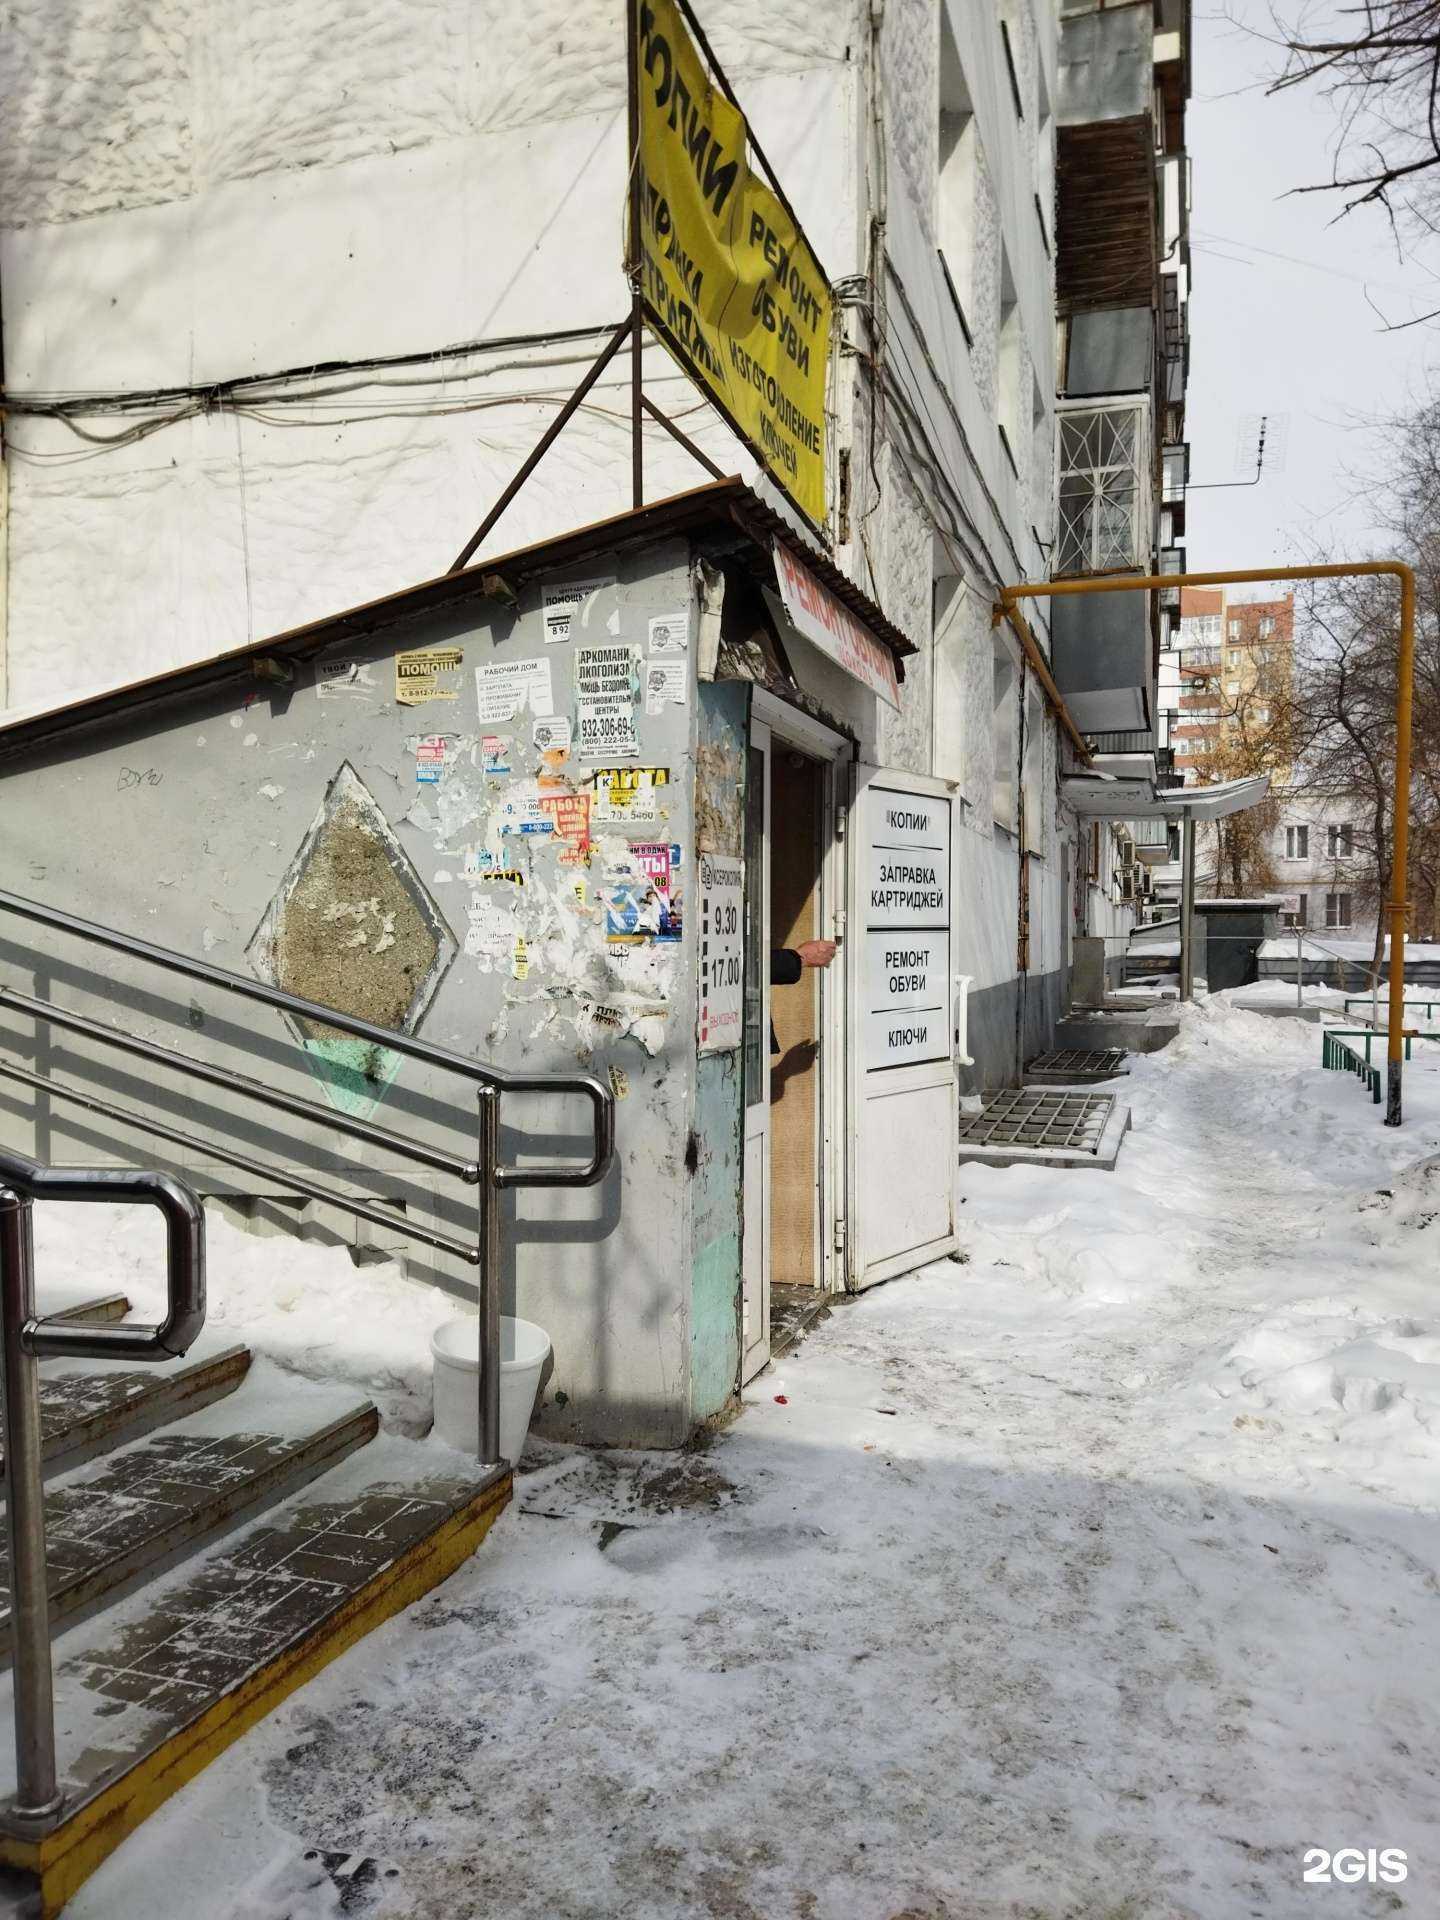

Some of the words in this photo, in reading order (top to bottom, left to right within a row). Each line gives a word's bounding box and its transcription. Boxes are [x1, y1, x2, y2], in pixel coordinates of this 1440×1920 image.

[750, 210, 822, 333] РЕМОНТ
[751, 278, 809, 377] ОБУВИ
[546, 593, 584, 606] ПОМОЩЬ
[579, 648, 630, 665] АРКОМАНИ
[484, 665, 519, 676] РАБОЧИЙ
[521, 663, 538, 672] ДОМ
[594, 705, 620, 716] ЦЕНТРЫ
[889, 810, 928, 831] КОПИИ
[879, 864, 936, 885] ЗАПРАВКА
[871, 887, 944, 910] КАРТРИДЖЕЙ
[714, 905, 738, 936] 9.30
[885, 950, 930, 969] РЕМОНТ
[711, 957, 740, 989] 17.00
[889, 974, 926, 993] ОБУВИ
[888, 1026, 927, 1048] КЛЮЧИ
